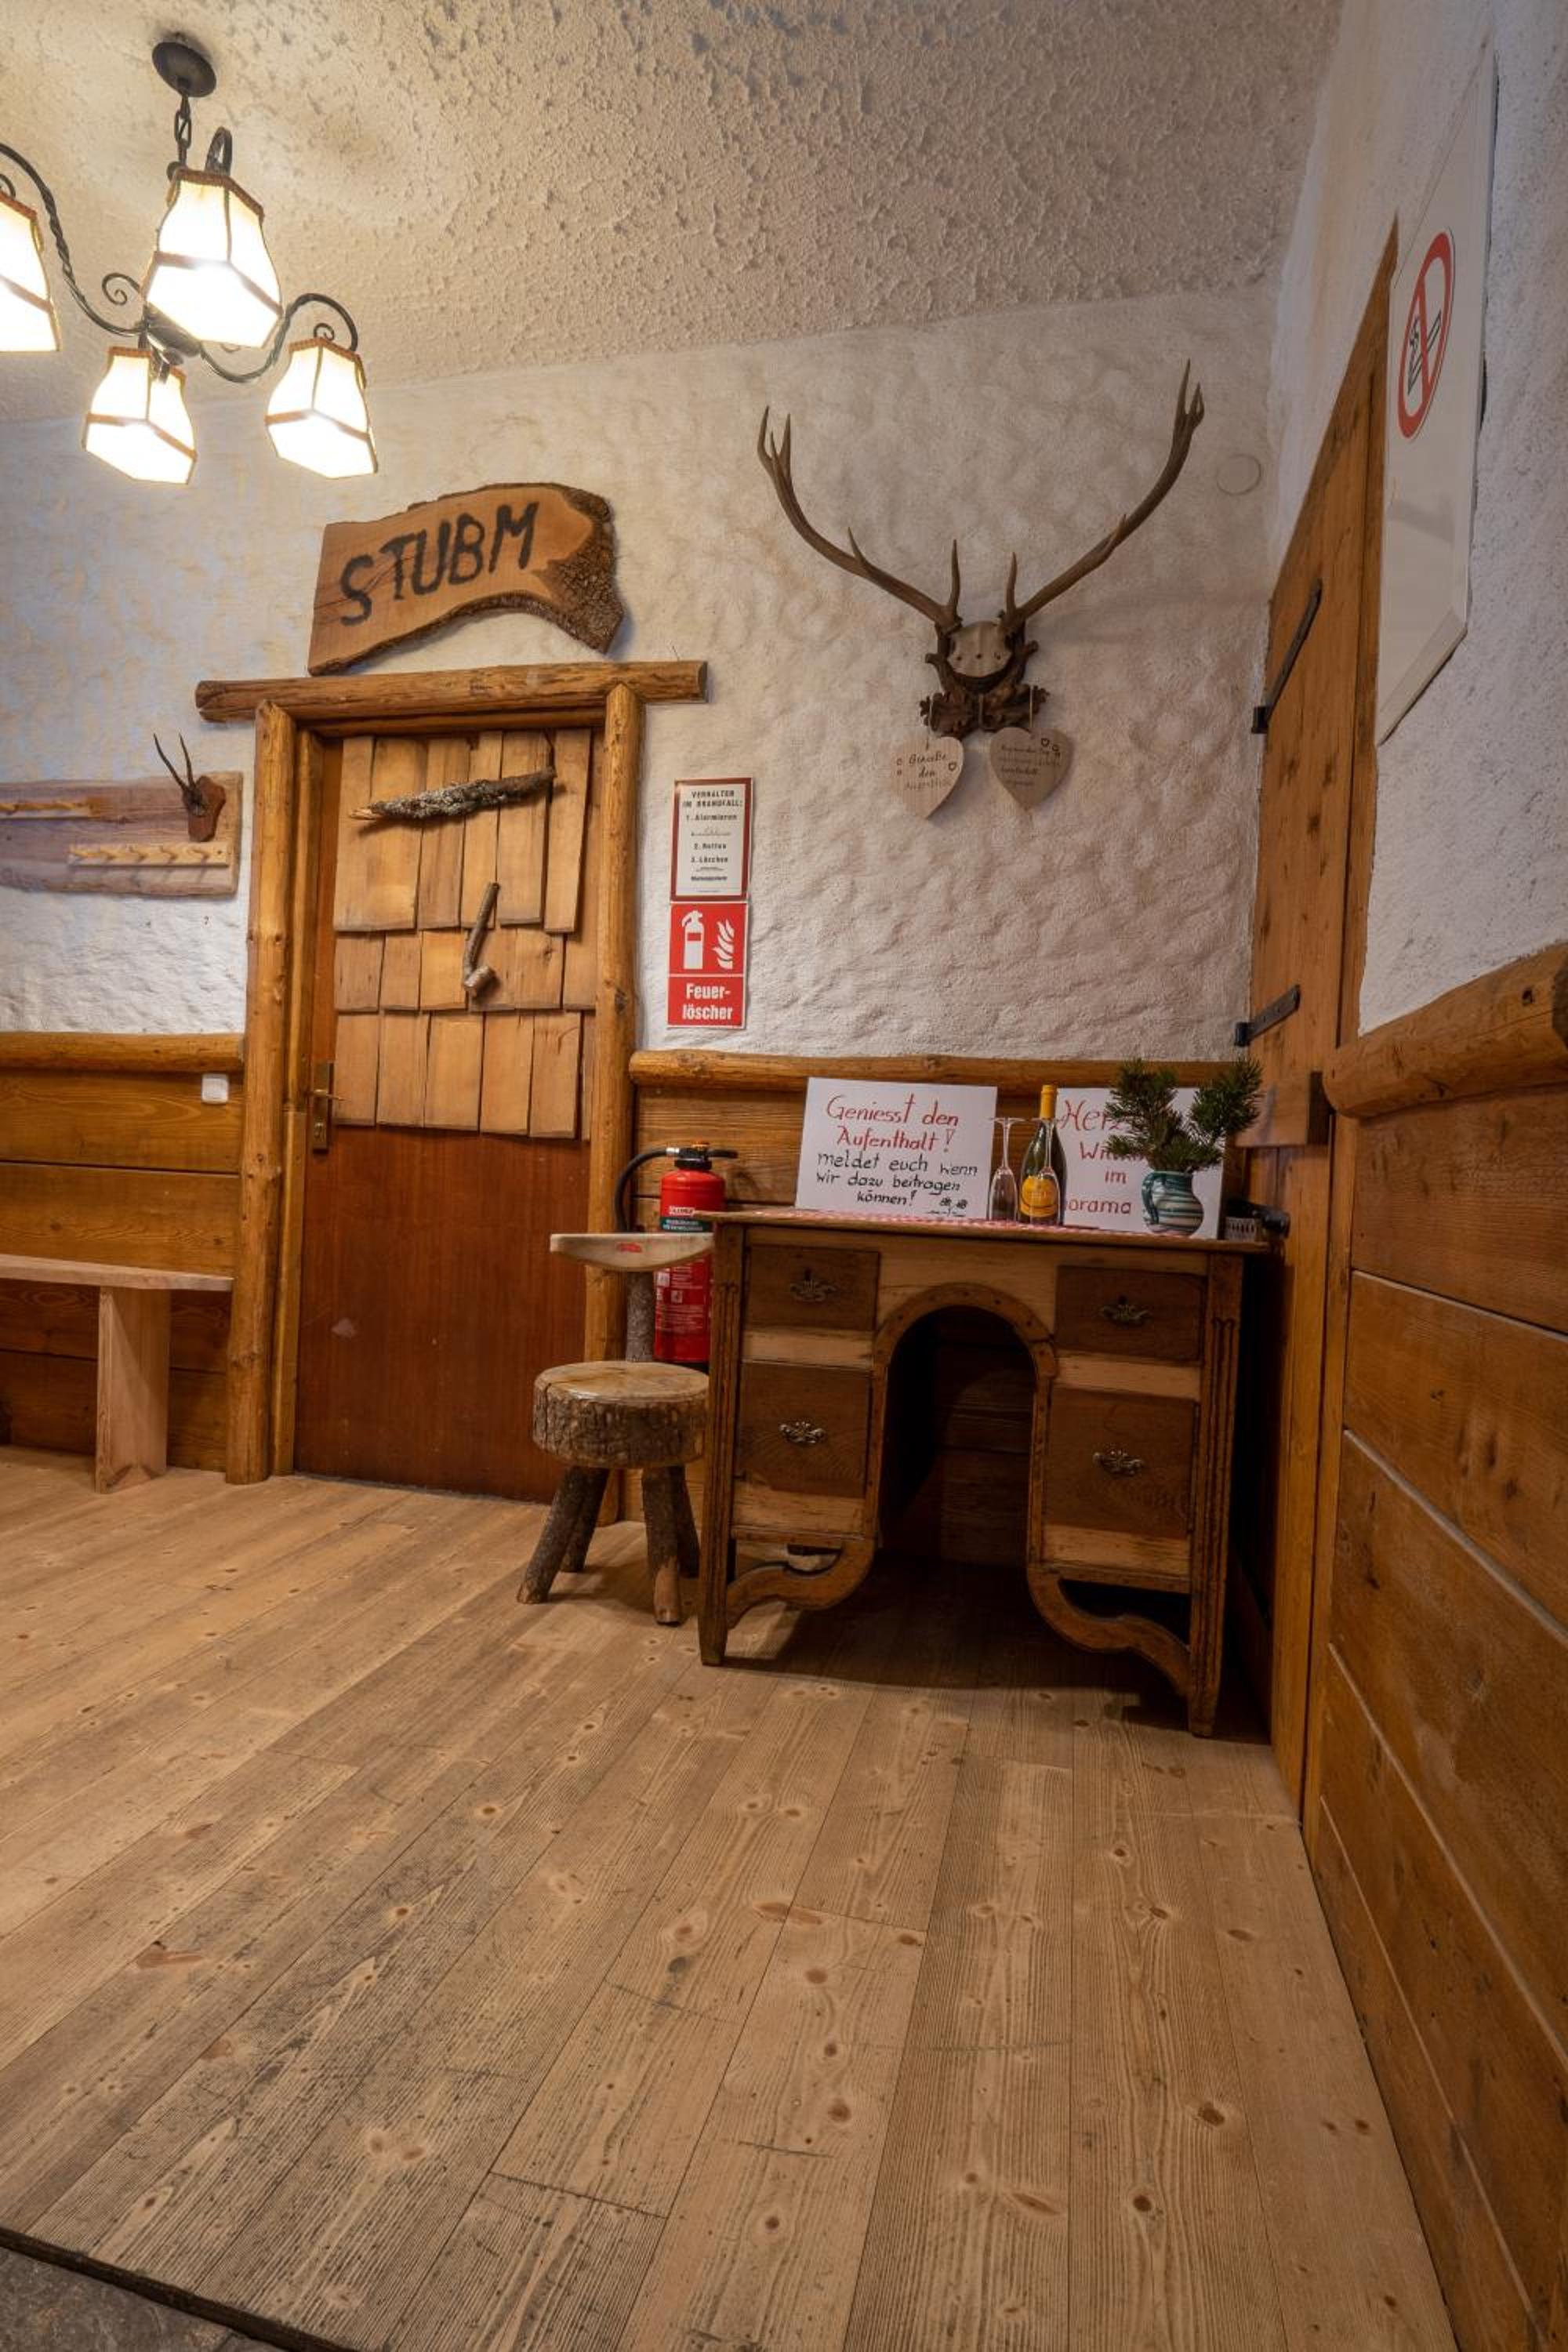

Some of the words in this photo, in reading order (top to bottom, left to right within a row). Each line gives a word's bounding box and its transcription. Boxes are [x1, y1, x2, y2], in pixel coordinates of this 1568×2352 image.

[339, 501, 539, 627] STUBM
[686, 982, 731, 1000] Feuer-
[682, 1004, 733, 1021] löscher
[826, 1093, 916, 1123] Geniesst
[921, 1100, 960, 1127] den
[817, 1149, 880, 1170] meldet
[887, 1153, 929, 1173] euch
[847, 1171, 884, 1189] dazu
[891, 1174, 962, 1196] beitragen
[1104, 1168, 1127, 1185] im
[1067, 1198, 1132, 1215] orama
